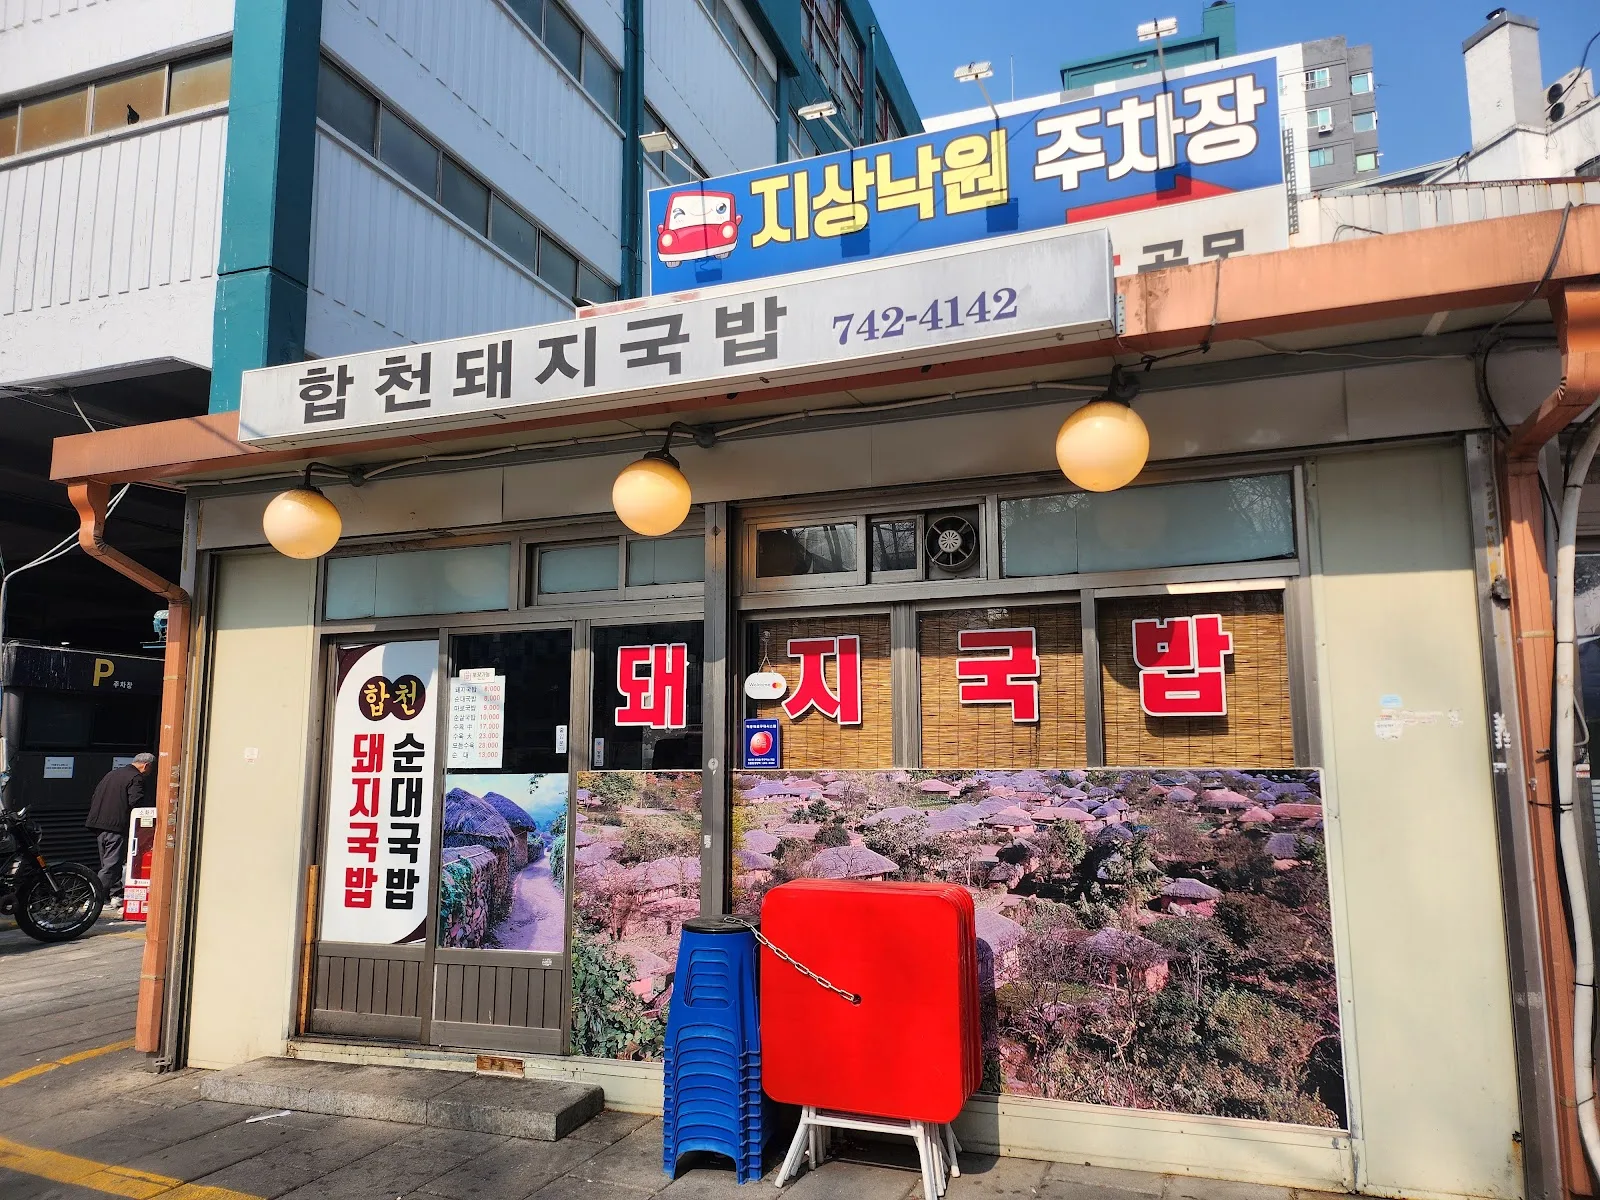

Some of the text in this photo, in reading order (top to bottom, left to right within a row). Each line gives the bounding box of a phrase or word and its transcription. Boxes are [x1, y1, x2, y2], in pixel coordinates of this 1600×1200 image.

[750, 73, 1267, 249] 지상낙원 주차장
[297, 287, 1019, 424] 합천돼지국밥 742-4142
[93, 658, 133, 690] P 주차장
[363, 680, 417, 718] 합천
[479, 713, 500, 721] 10,000
[479, 723, 500, 731] 17,000
[344, 733, 385, 909] 돼지국밥
[385, 732, 425, 910] 순대국밥
